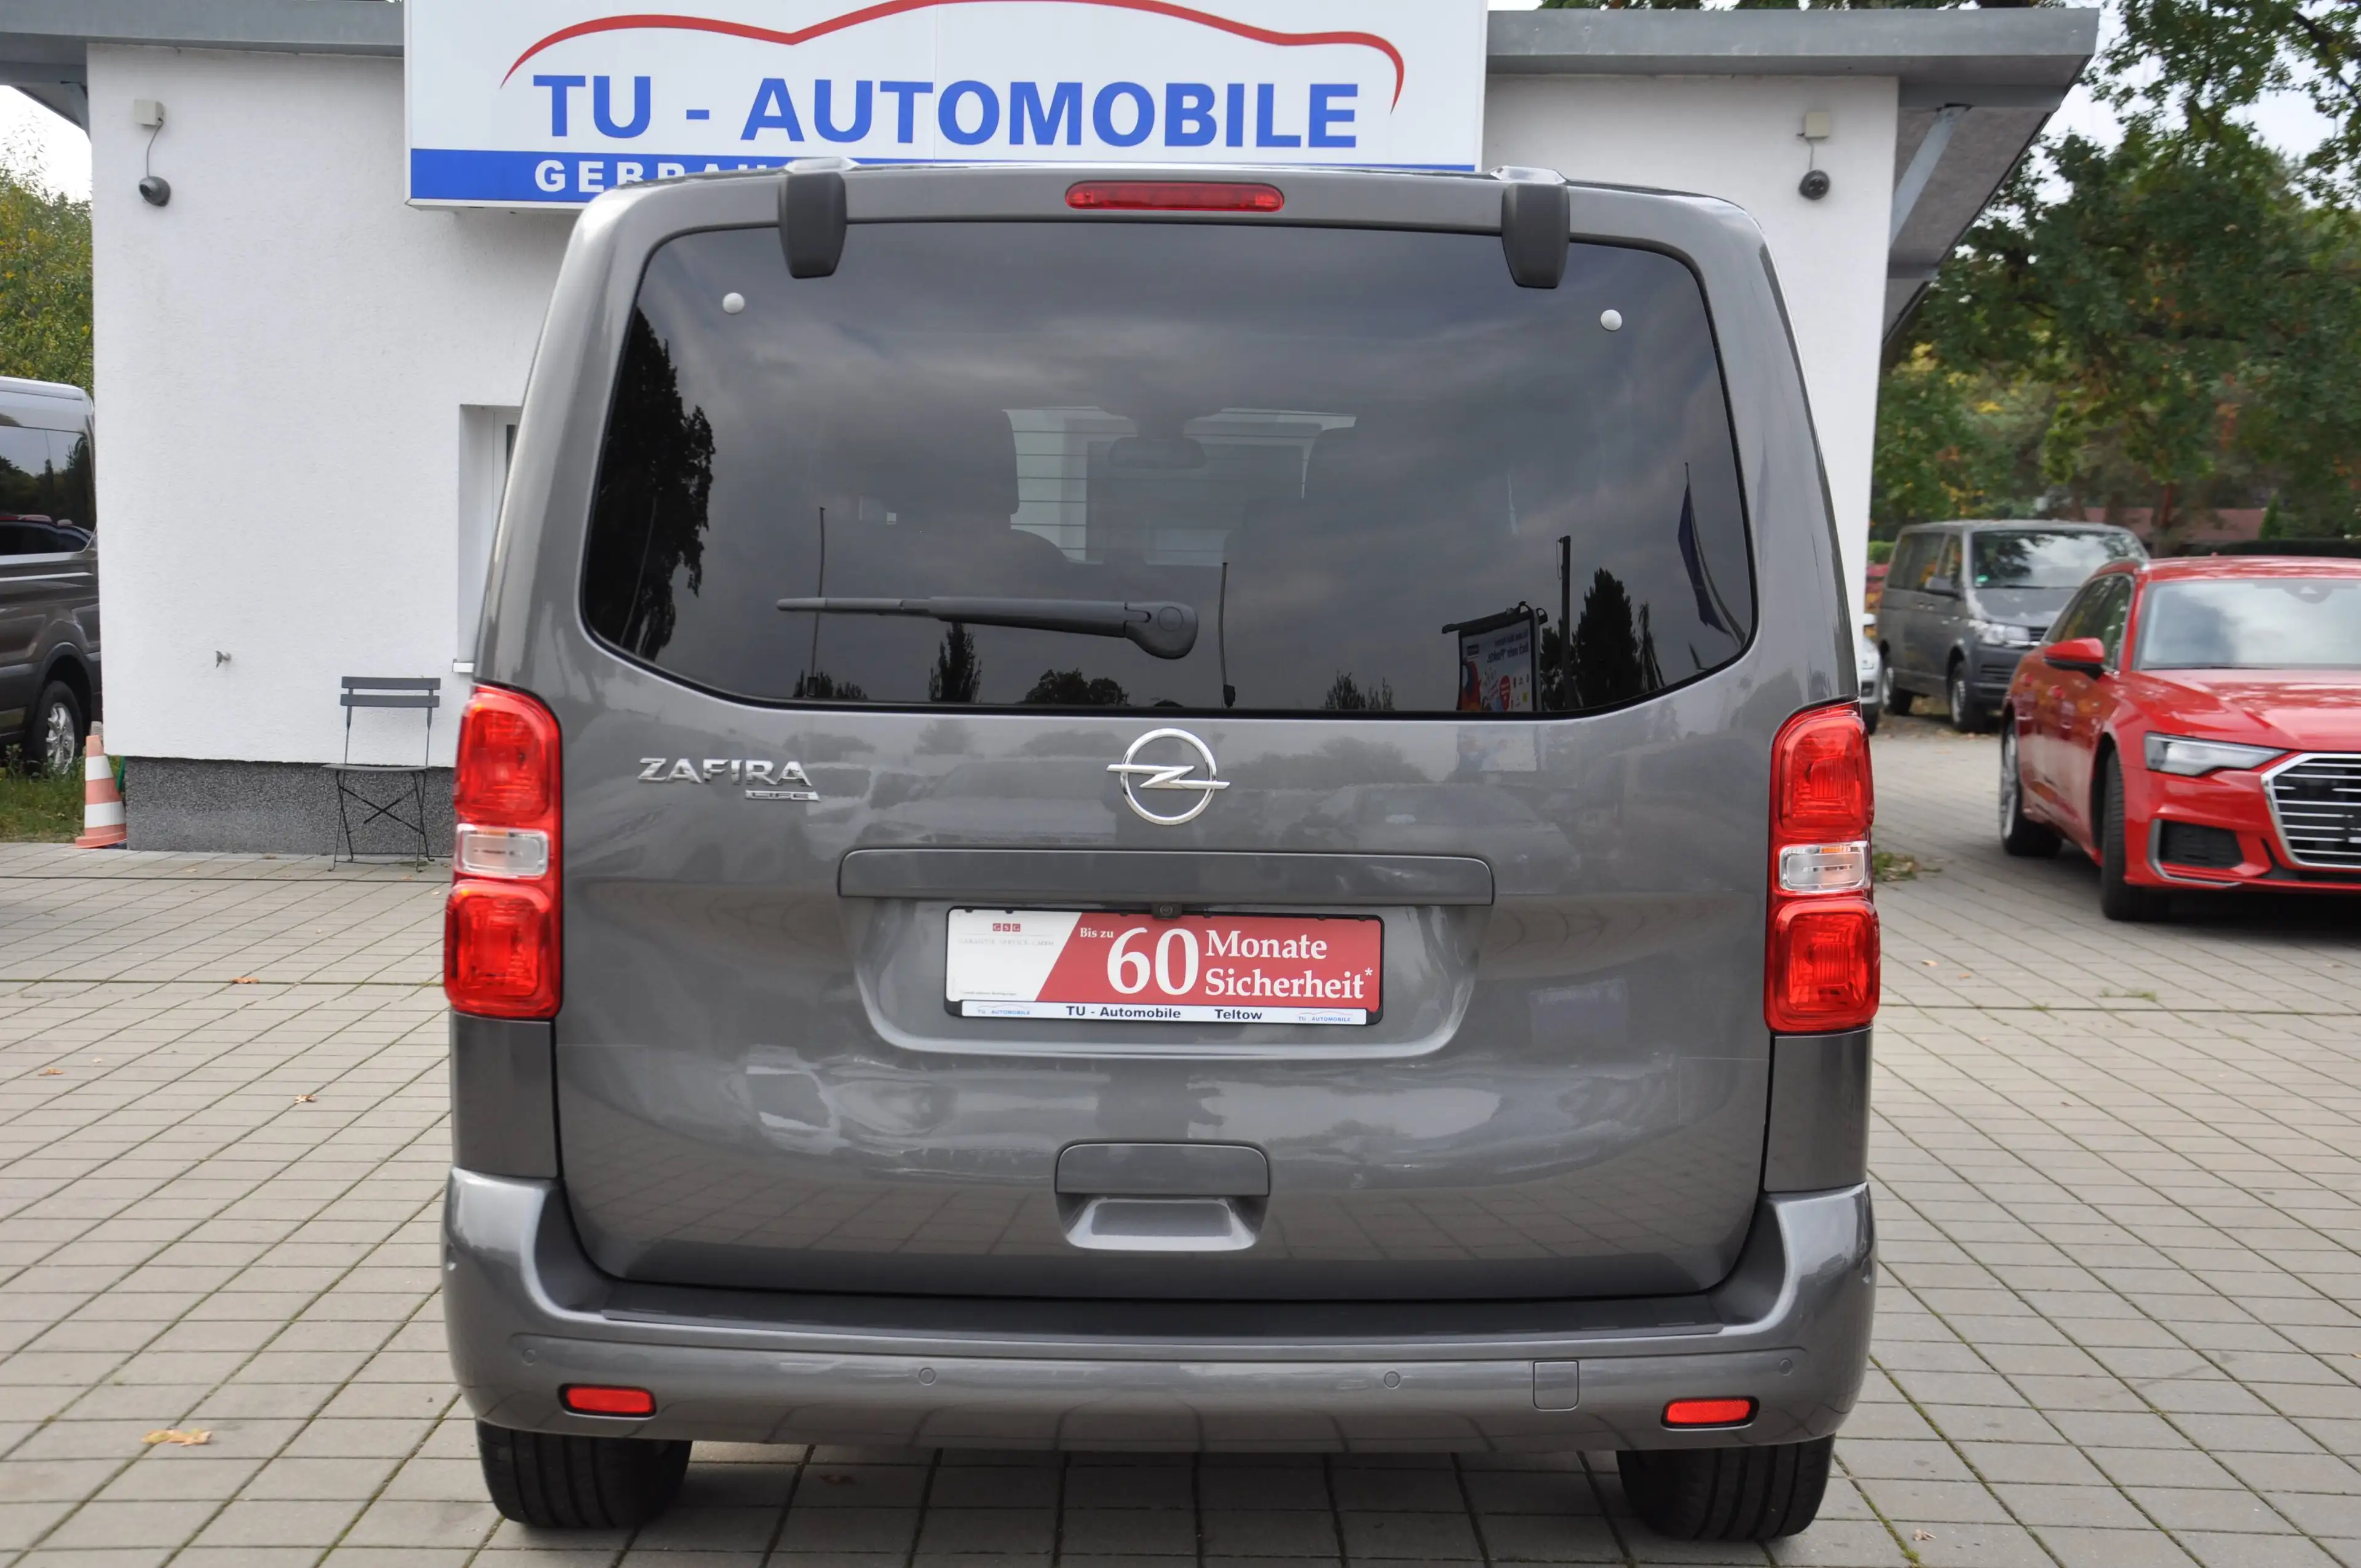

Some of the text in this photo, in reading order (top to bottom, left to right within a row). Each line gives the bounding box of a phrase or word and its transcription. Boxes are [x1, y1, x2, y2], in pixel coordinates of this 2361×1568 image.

[533, 75, 651, 138] TU
[740, 77, 1359, 149] AUTOMOBILE
[638, 758, 812, 786] ZAFIRA
[992, 923, 1021, 932] GSG
[1080, 927, 1096, 938] Bis
[1206, 930, 1327, 959] Monate
[1107, 927, 1199, 996] 60
[1066, 1006, 1086, 1016] TU
[1100, 1007, 1181, 1018] Automobile
[1215, 1008, 1262, 1020] Teltow
